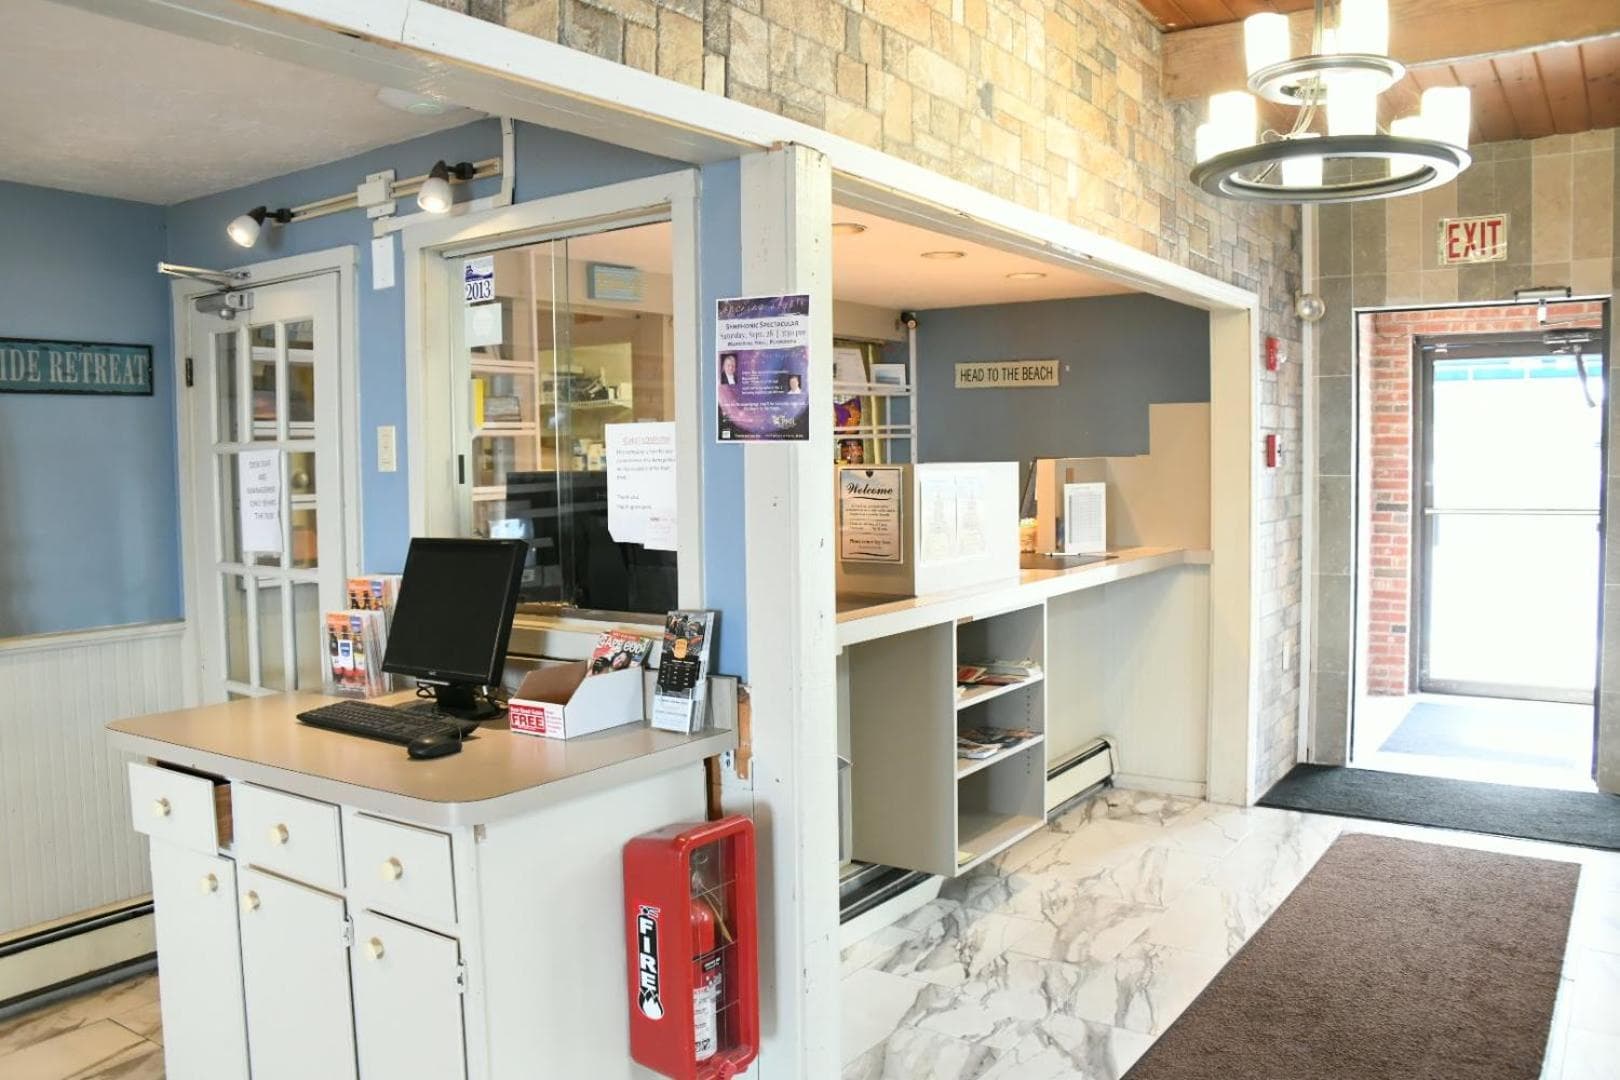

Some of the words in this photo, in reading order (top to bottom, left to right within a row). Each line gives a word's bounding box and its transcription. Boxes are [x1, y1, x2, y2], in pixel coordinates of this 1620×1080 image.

[1448, 220, 1502, 259] EXIT
[465, 280, 491, 300] 2013
[48, 350, 147, 385] RETREAT
[960, 367, 985, 382] HEAD
[987, 367, 999, 382] TO
[1002, 366, 1020, 381] THE
[1022, 365, 1053, 381] BEACH
[847, 482, 893, 495] Welcome
[511, 713, 545, 729] FREE
[639, 916, 658, 991] FIRE
